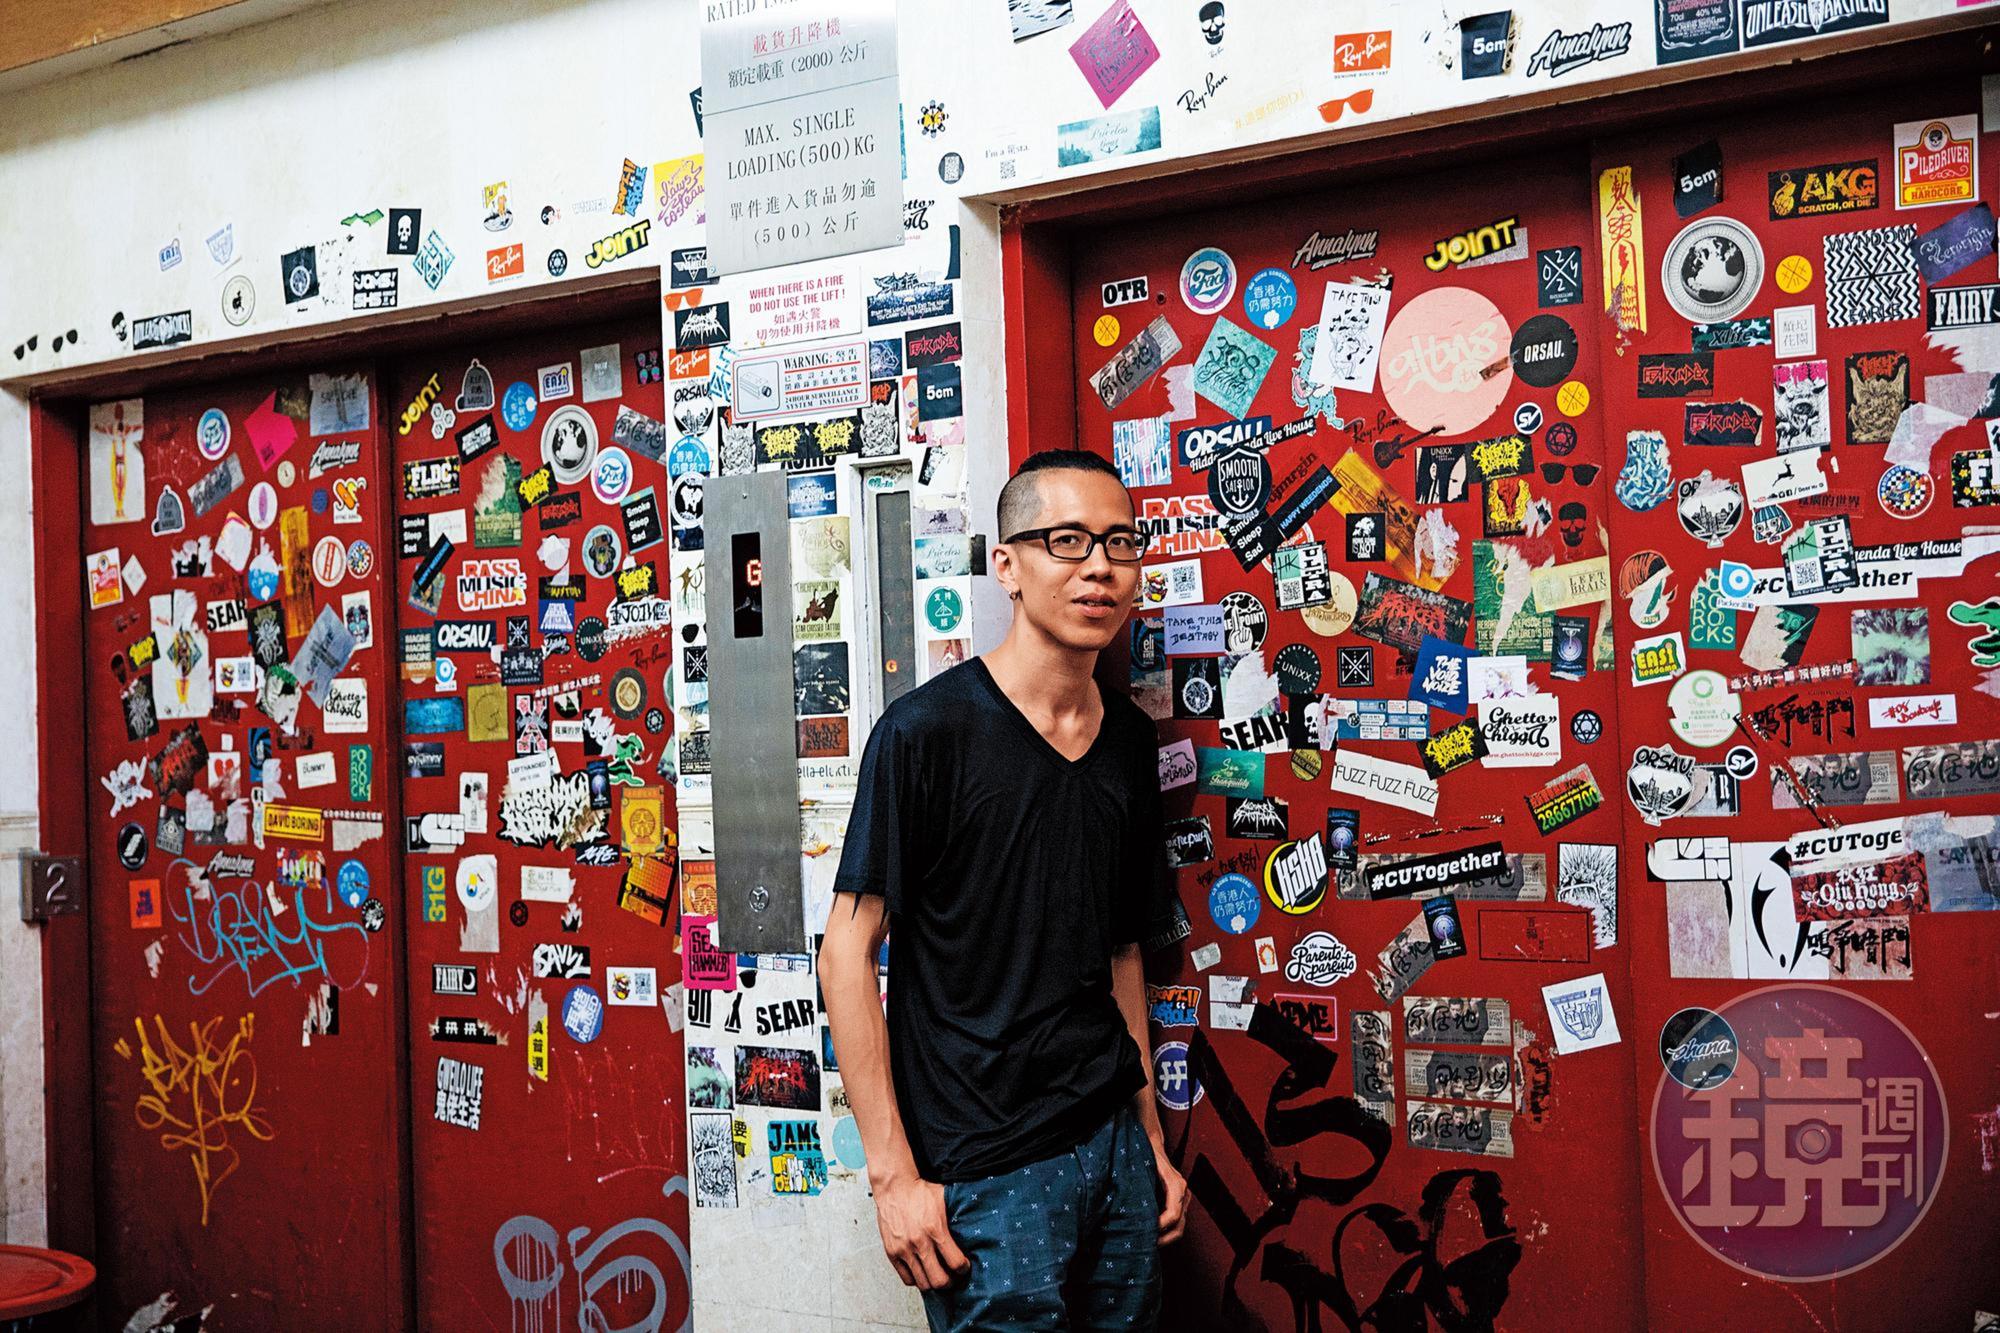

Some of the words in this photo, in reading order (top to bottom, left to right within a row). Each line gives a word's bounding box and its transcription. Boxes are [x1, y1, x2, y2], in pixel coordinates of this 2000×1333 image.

[753, 17, 841, 54] 載貨升降機
[1472, 38, 1507, 56] 5cm
[728, 60, 784, 88] 額定載重
[791, 50, 832, 74] (2000)
[840, 41, 868, 63] 公斤
[1177, 72, 1229, 113] Ray-Ban
[744, 124, 780, 147] MAX.
[793, 108, 855, 138] SINGLE
[1904, 146, 1969, 183] PILEDRIVER
[1681, 168, 1717, 193] 5cm
[1802, 168, 1876, 201] AKG
[1911, 186, 1963, 199] HARDCORE
[730, 178, 876, 221] 單件進入貨品勿逾
[586, 219, 651, 269] JOINT
[1424, 217, 1517, 272] JOINT
[750, 287, 775, 299] WHEN
[778, 281, 804, 295] THERE
[806, 280, 814, 290] IS
[817, 279, 822, 288] A
[825, 275, 843, 287] FIRE
[1104, 279, 1147, 304] OTR
[1254, 282, 1286, 298] 香港人
[750, 303, 761, 313] DO
[764, 299, 781, 311] NOT
[784, 296, 799, 308] USE
[803, 293, 818, 305] THE
[822, 289, 839, 301] LIFT
[1249, 296, 1293, 312] 仍需努力
[1935, 288, 1993, 325] FAIRY
[757, 318, 840, 340] 切勿使用升降機
[1524, 341, 1565, 363] ORSAU.
[399, 373, 442, 435] JOINT
[926, 385, 954, 400] 5cm
[1221, 459, 1258, 482] SMOOTH
[1280, 507, 1301, 530] HAPPY
[1237, 525, 1263, 549] Sleep
[1921, 541, 1962, 556] House
[1245, 544, 1264, 561] Sad
[1569, 571, 1606, 587] LEFT
[1570, 580, 1607, 595] BRAIN
[1241, 612, 1264, 625] POINT
[438, 623, 492, 648] ORSAU.
[1435, 655, 1462, 671] THE
[1335, 764, 1366, 785] FUZZ
[1369, 774, 1402, 795] FUZZ
[1404, 781, 1438, 804] FUZZ
[1538, 786, 1600, 830] 28667700
[268, 813, 290, 827] DAVID
[292, 817, 318, 831] BORING
[1795, 829, 1903, 858] #CUToge
[46, 863, 67, 902] 2
[1371, 851, 1502, 891] #CUTogether
[1217, 887, 1252, 903] 香港人
[757, 999, 815, 1035] SEAR
